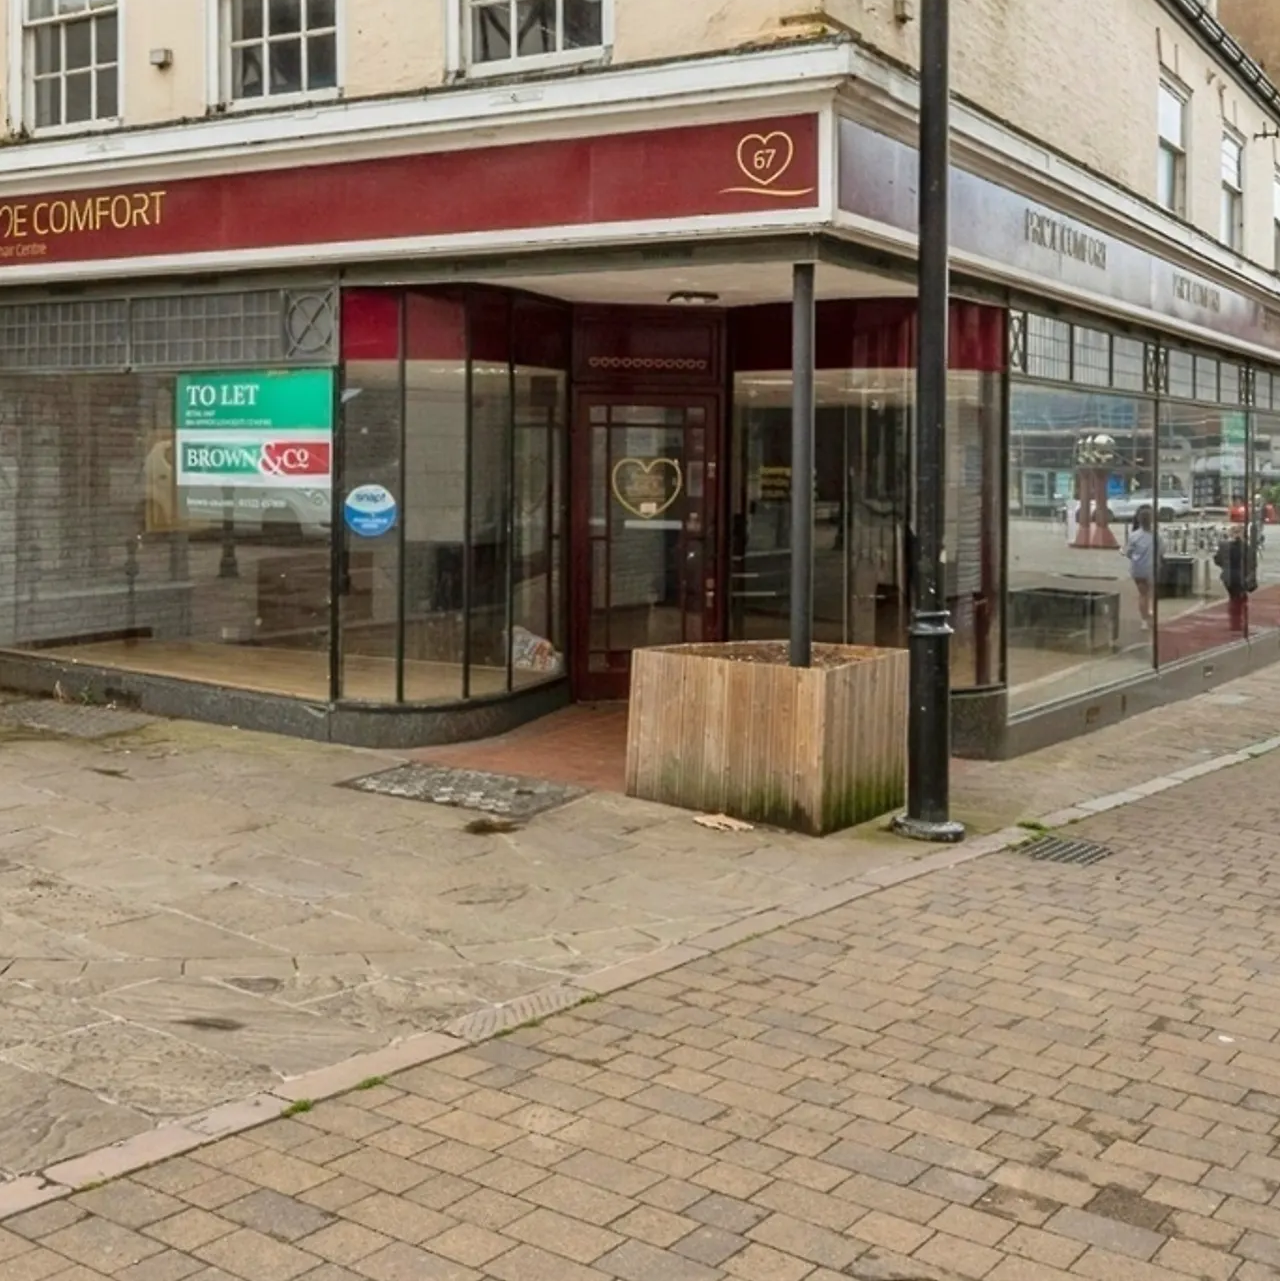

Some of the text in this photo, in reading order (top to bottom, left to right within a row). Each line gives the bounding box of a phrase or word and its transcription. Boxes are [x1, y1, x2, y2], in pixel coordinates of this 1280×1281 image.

[753, 148, 777, 170] 67
[33, 191, 167, 235] COMFORT
[16, 242, 47, 257] Centre
[186, 384, 260, 406] TO LET
